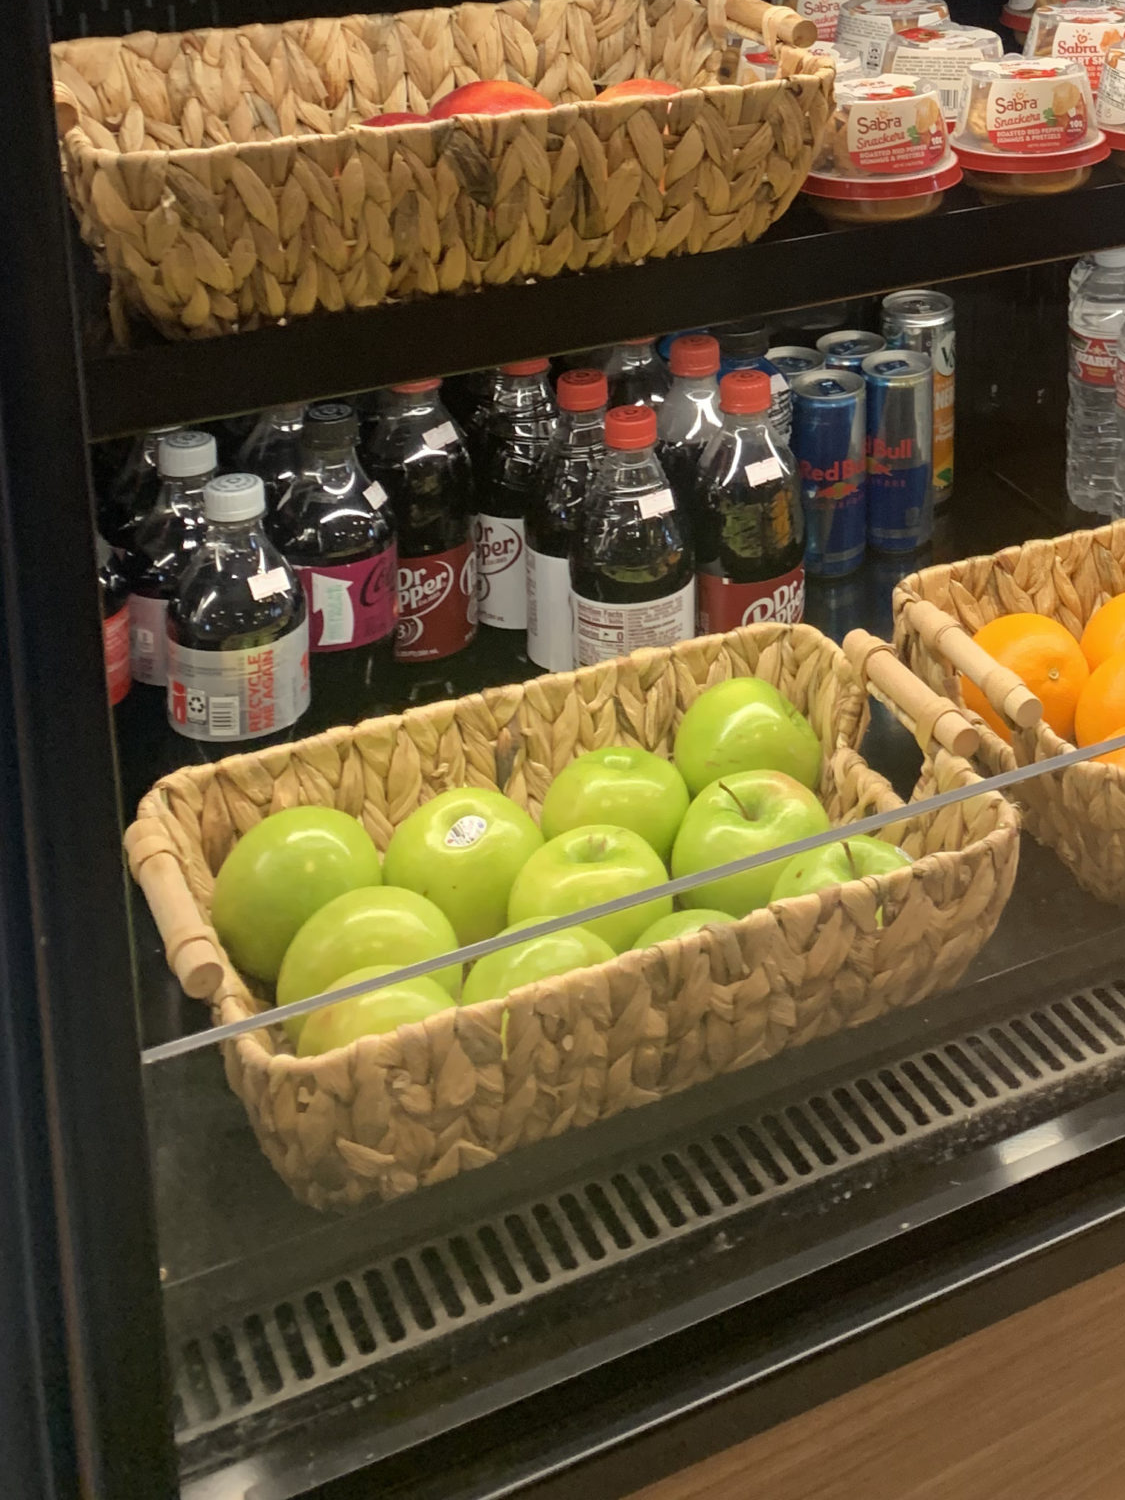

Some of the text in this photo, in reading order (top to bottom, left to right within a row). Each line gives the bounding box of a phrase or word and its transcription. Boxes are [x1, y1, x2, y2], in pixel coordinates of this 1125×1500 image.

[804, 0, 840, 15] Sabra
[1057, 39, 1098, 55] Sabra
[995, 97, 1037, 114] Sabra
[857, 116, 902, 135] Sabra
[994, 113, 1040, 128] Snackers
[996, 129, 1026, 138] ROASTED
[873, 438, 913, 460] Bull
[800, 460, 840, 482] Red
[248, 653, 262, 732] RECYCLE
[262, 649, 275, 729] ME AGAIN
